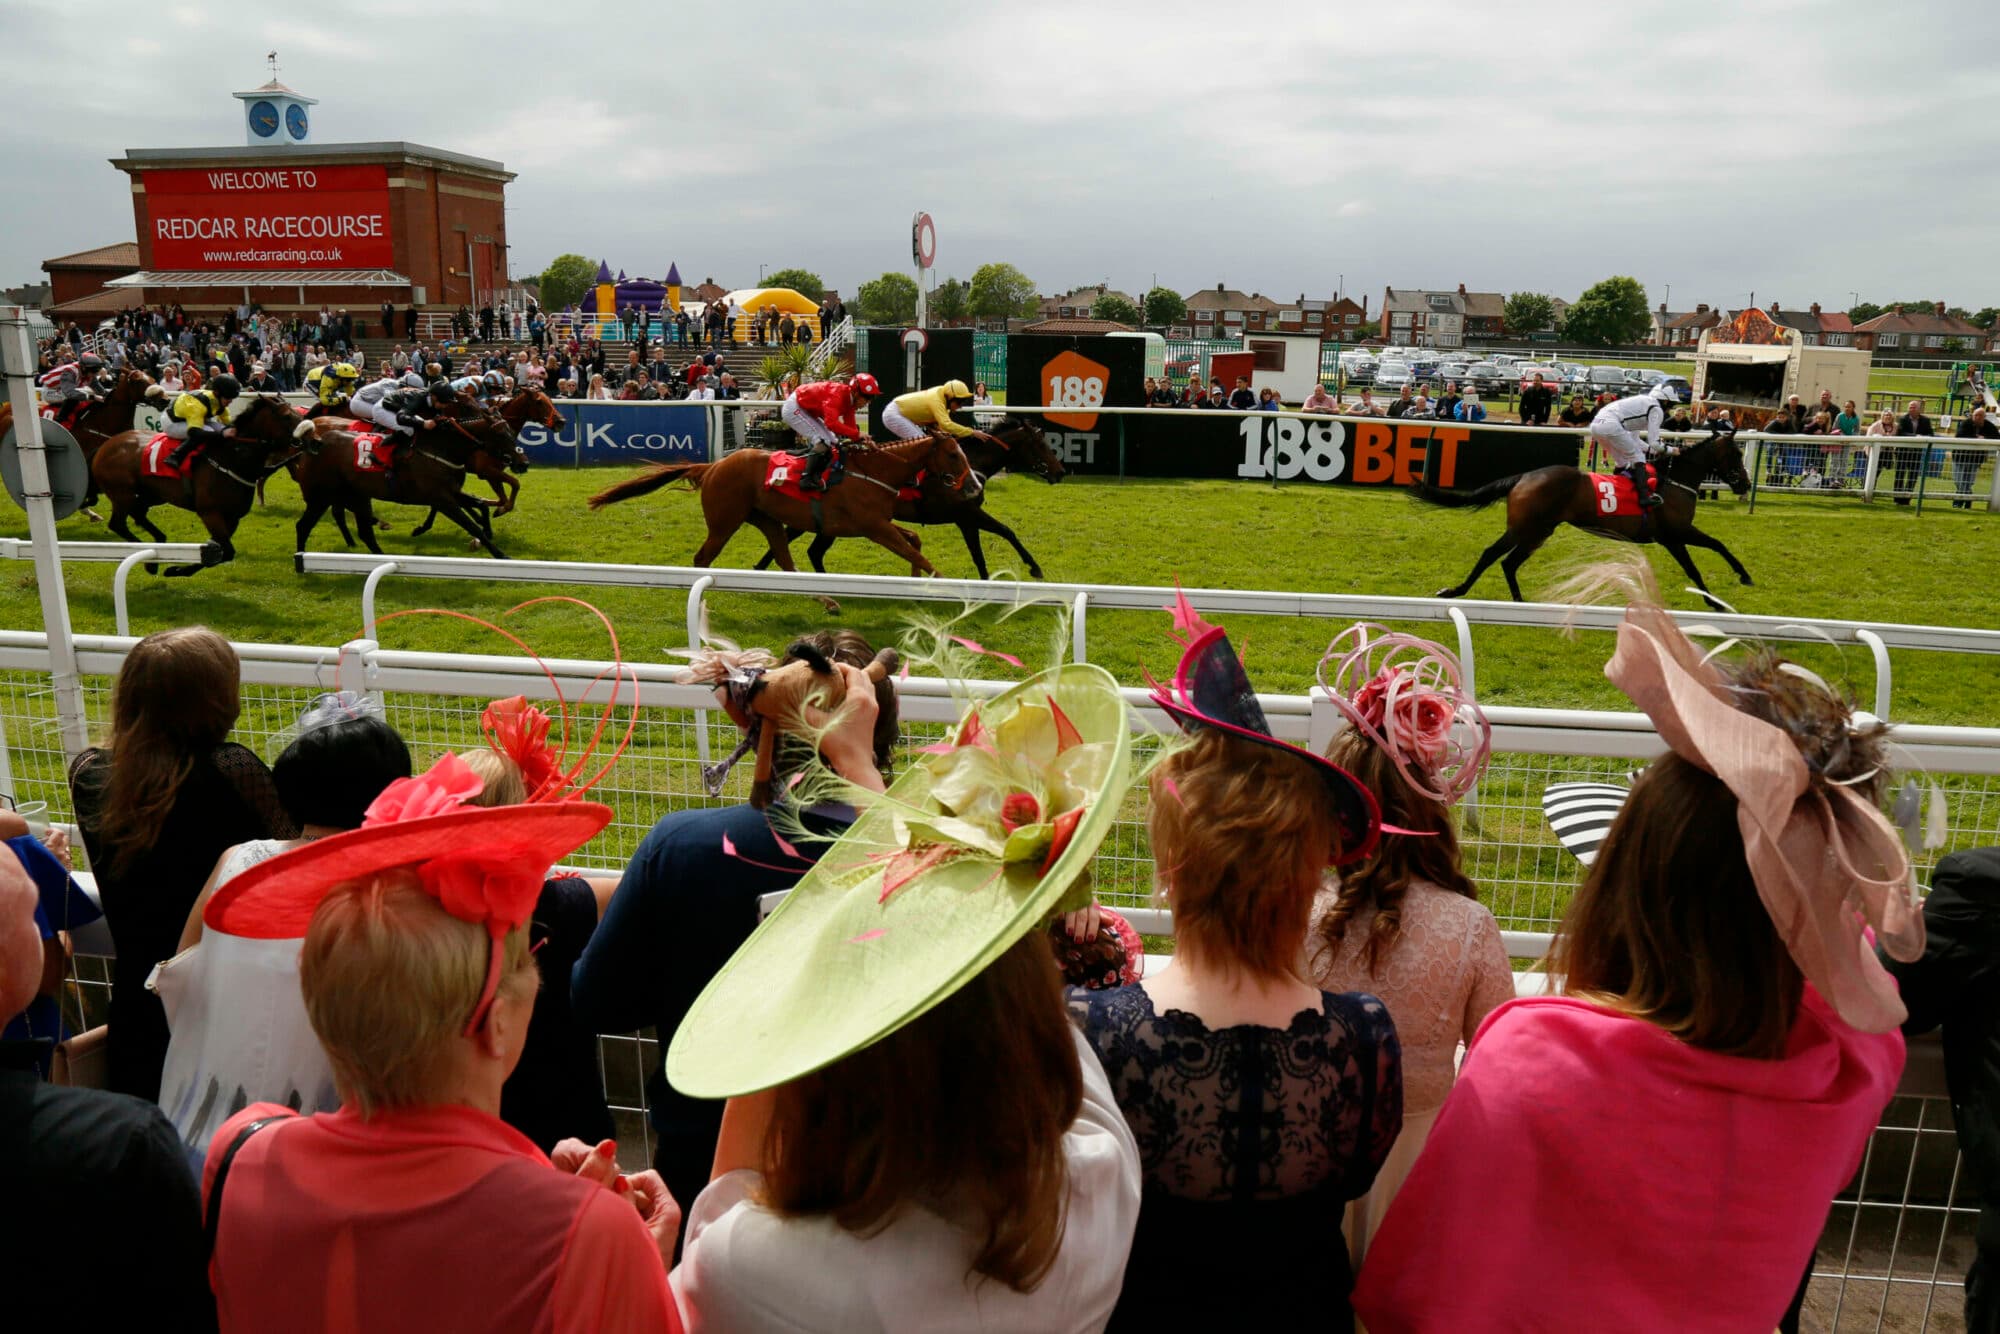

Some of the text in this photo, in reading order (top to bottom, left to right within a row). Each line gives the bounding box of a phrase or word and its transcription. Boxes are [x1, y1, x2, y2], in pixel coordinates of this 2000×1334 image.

[208, 170, 317, 190] WELCOME TO
[157, 215, 383, 239] REDCAR RACECOURSE
[203, 247, 342, 264] www.redcarracing.co.uk
[1050, 376, 1104, 407] 188
[150, 441, 163, 473] 1
[358, 440, 373, 468] 6
[1045, 432, 1100, 463] BET
[1598, 482, 1618, 513] 3
